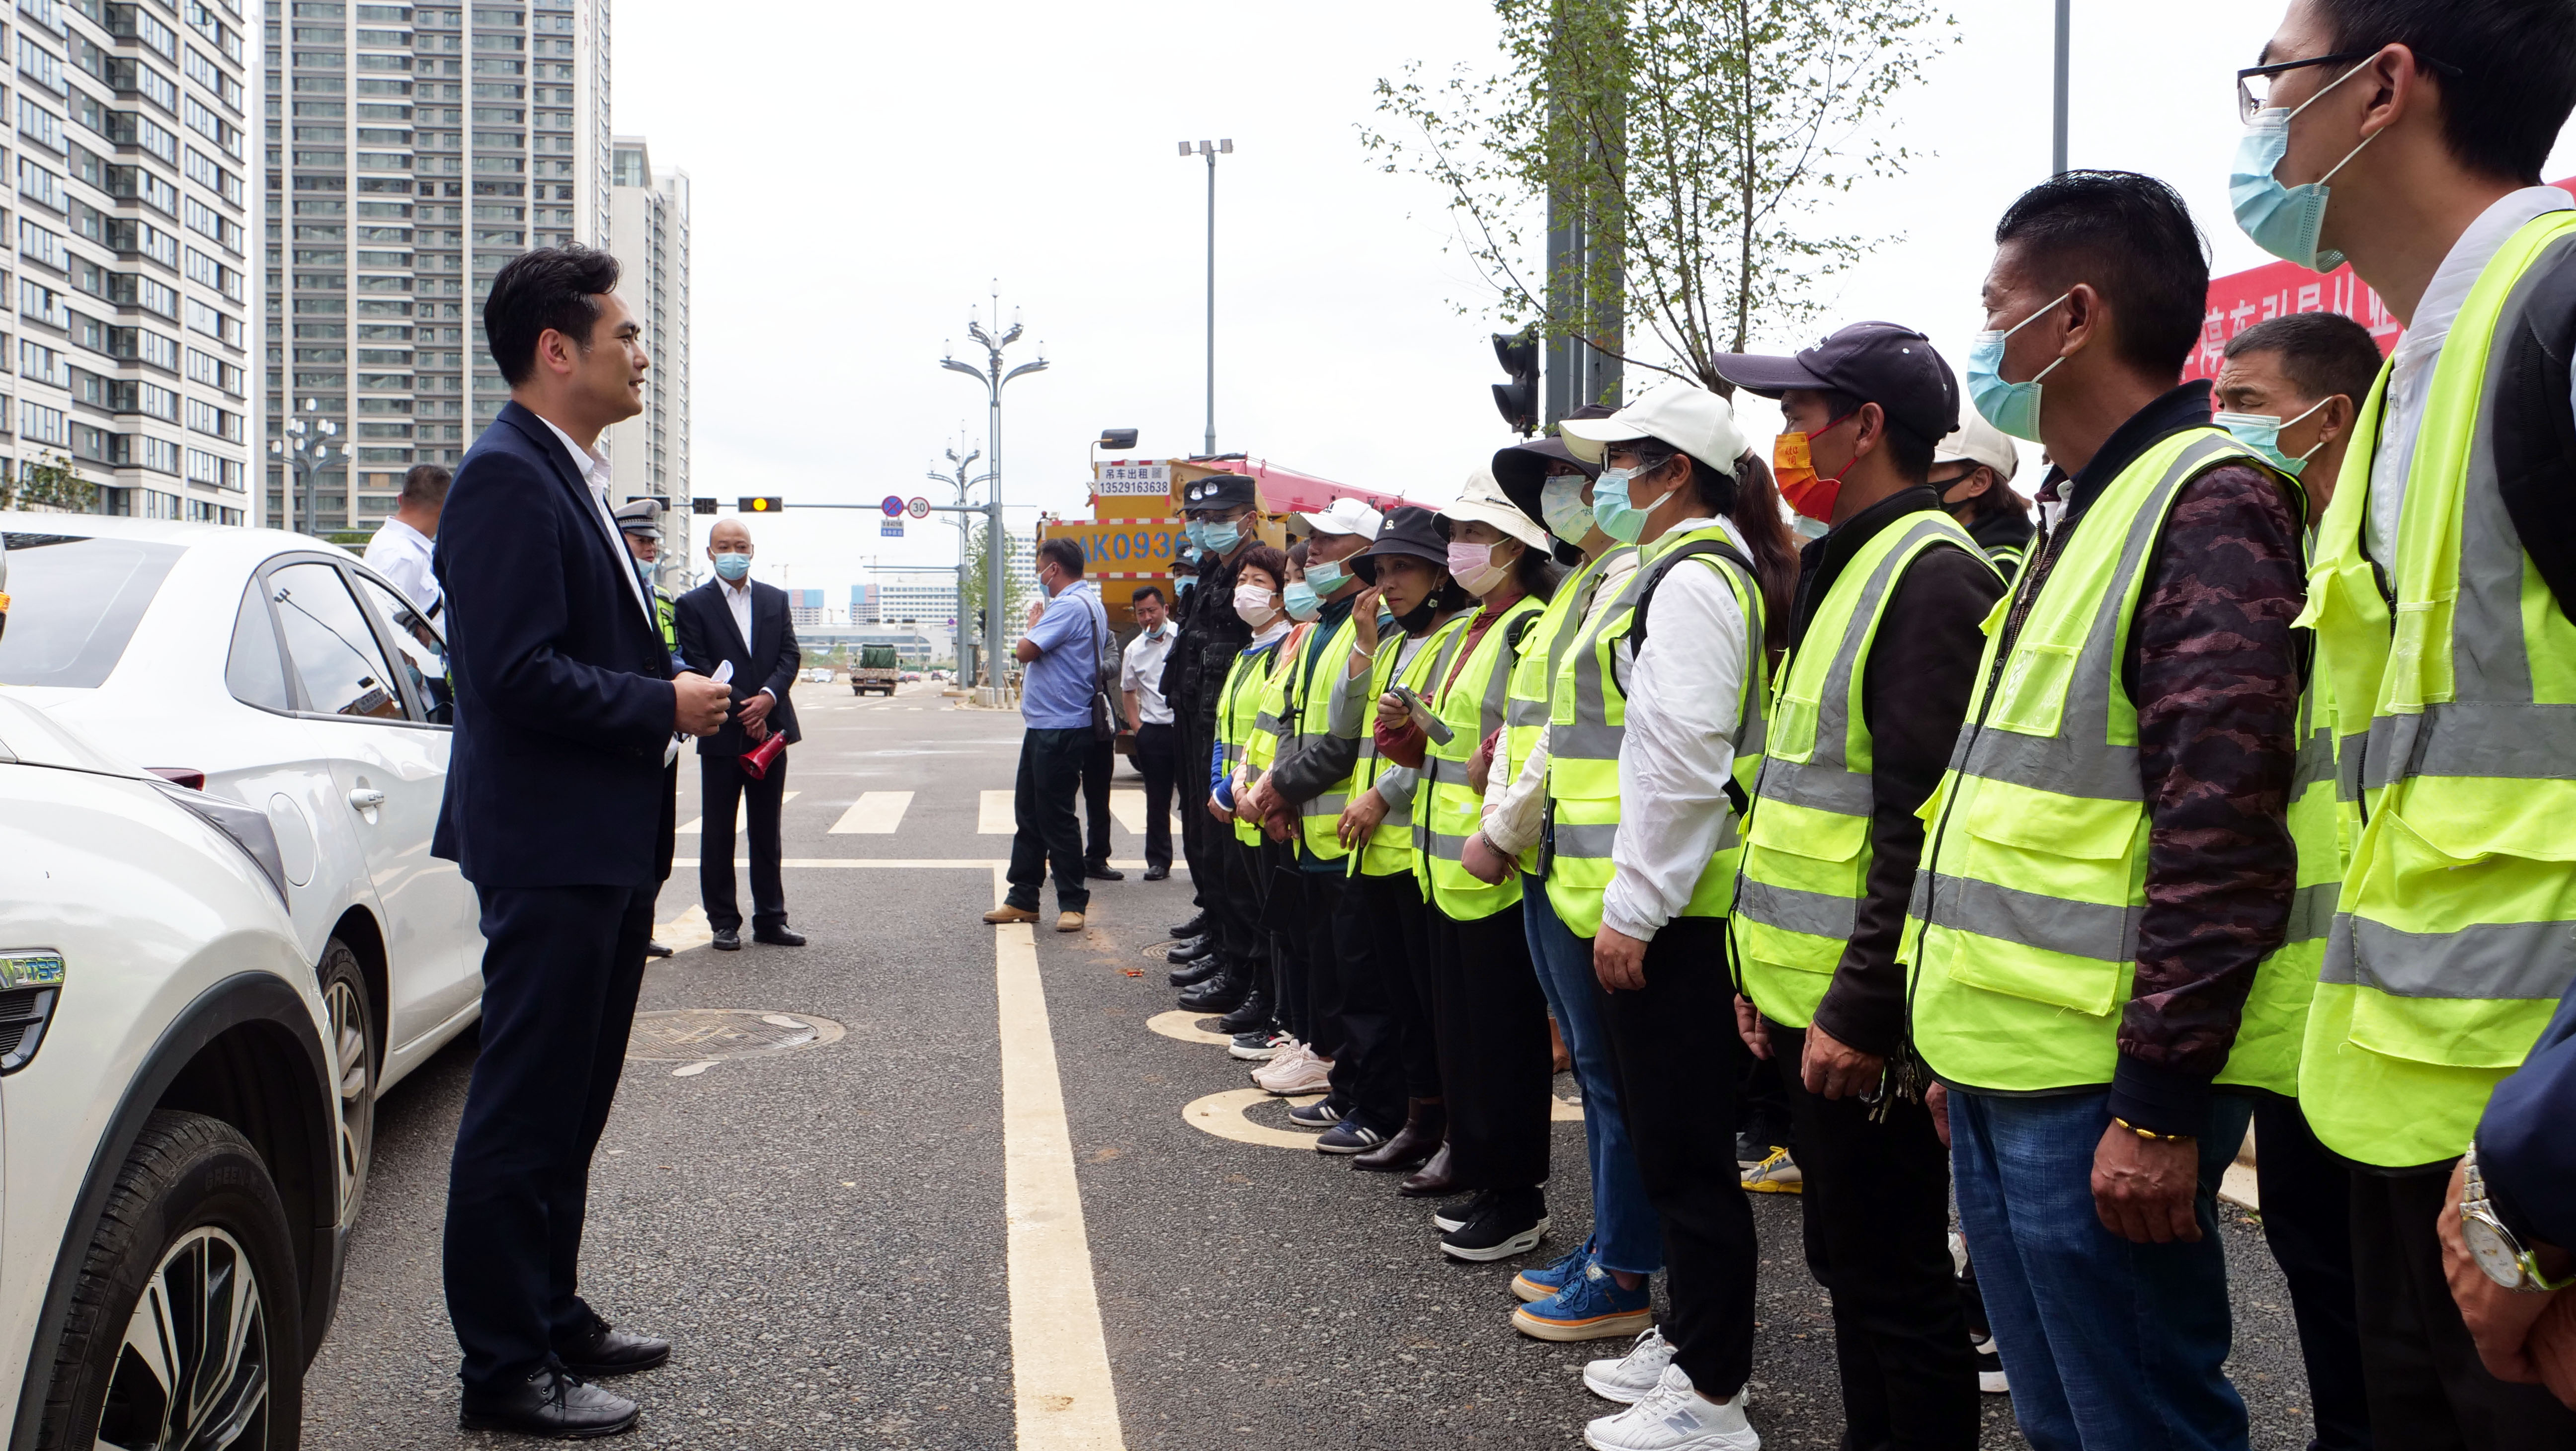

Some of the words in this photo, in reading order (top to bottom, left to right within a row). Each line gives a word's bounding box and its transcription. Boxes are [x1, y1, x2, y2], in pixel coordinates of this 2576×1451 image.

[2181, 271, 2398, 381] 停车引导从业
[1106, 469, 1148, 479] 吊车出租
[1100, 482, 1168, 493] 13529163638
[913, 503, 925, 512] 30
[1662, 1408, 1703, 1437] N
